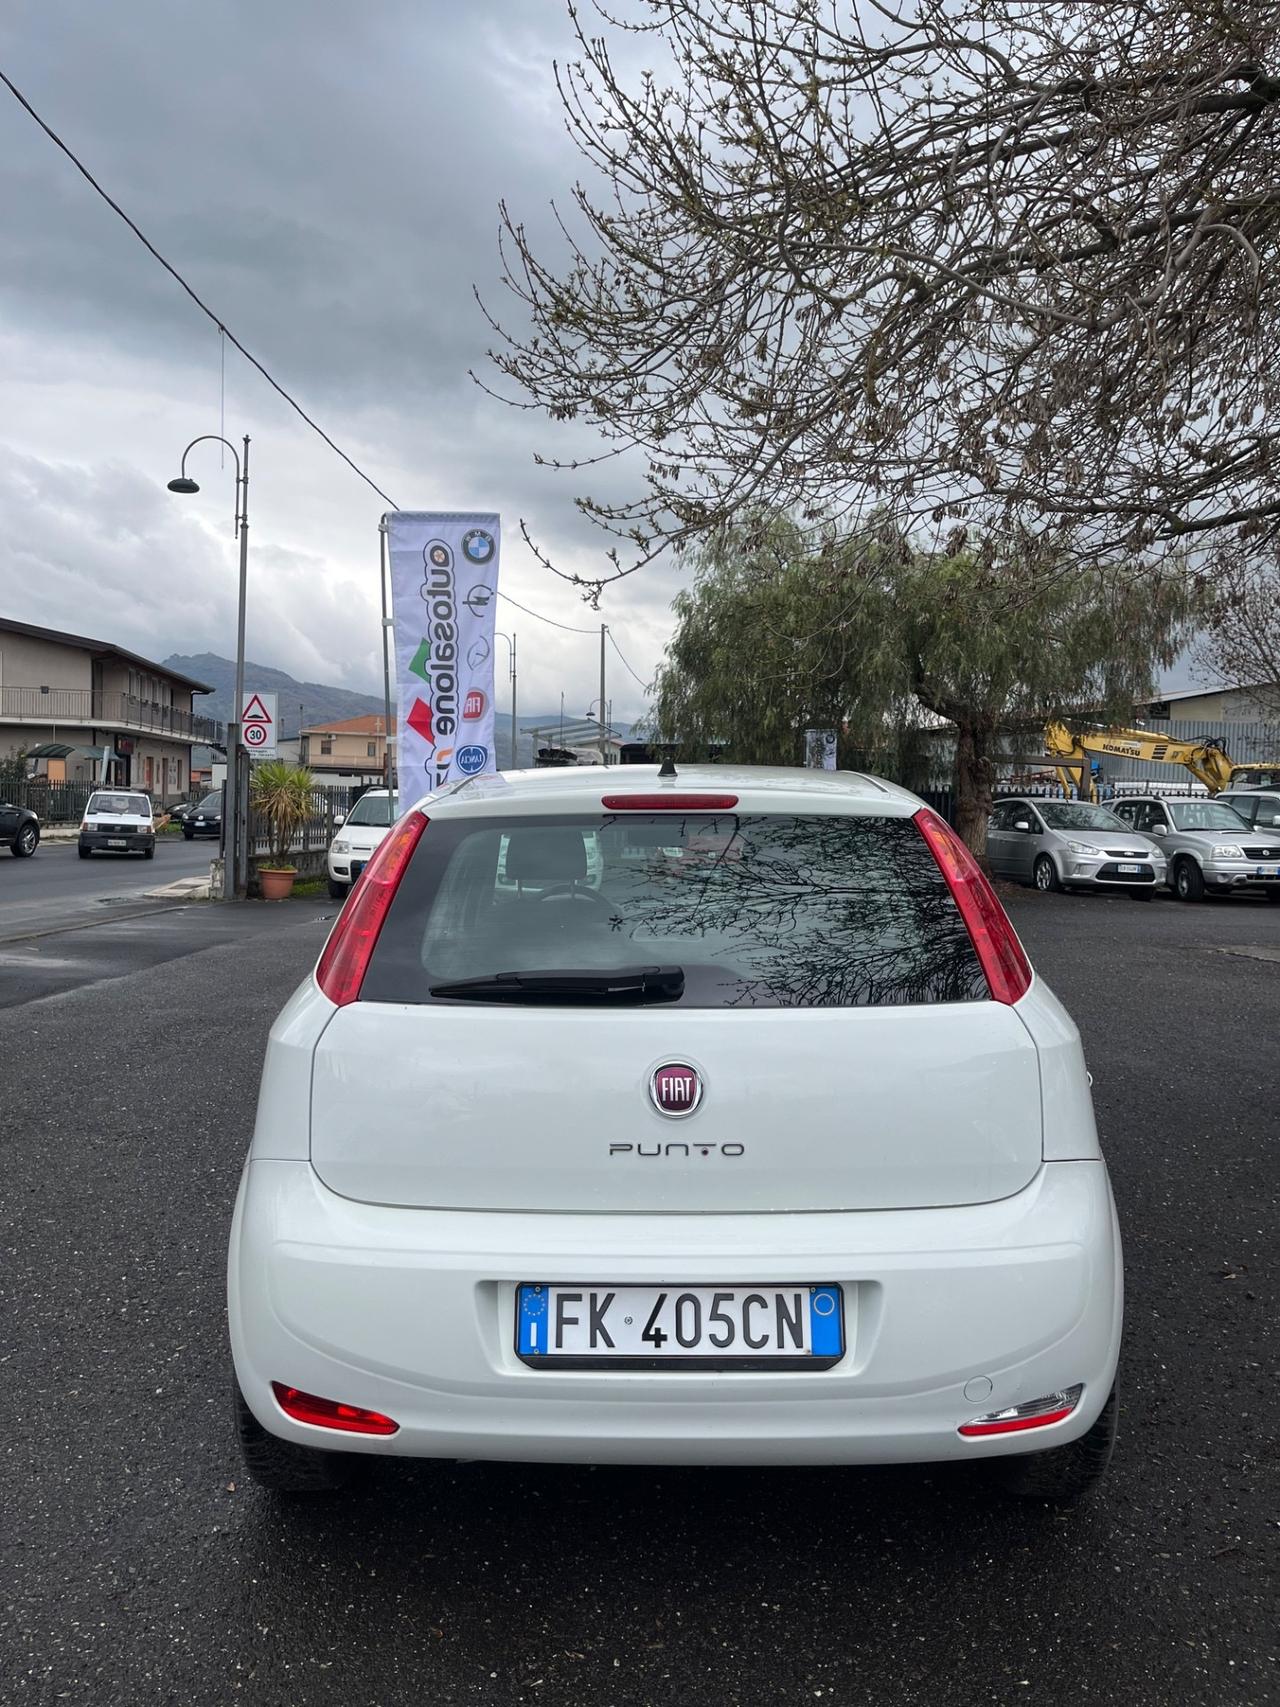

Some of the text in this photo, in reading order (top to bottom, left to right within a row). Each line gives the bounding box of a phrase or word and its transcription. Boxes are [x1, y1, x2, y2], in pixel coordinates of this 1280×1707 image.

[250, 730, 262, 740] 30
[1103, 743, 1141, 757] KOMATSU
[661, 1077, 692, 1102] FIAT
[609, 1143, 745, 1156] PUNTO
[530, 1293, 804, 1350] I FK 405CN
